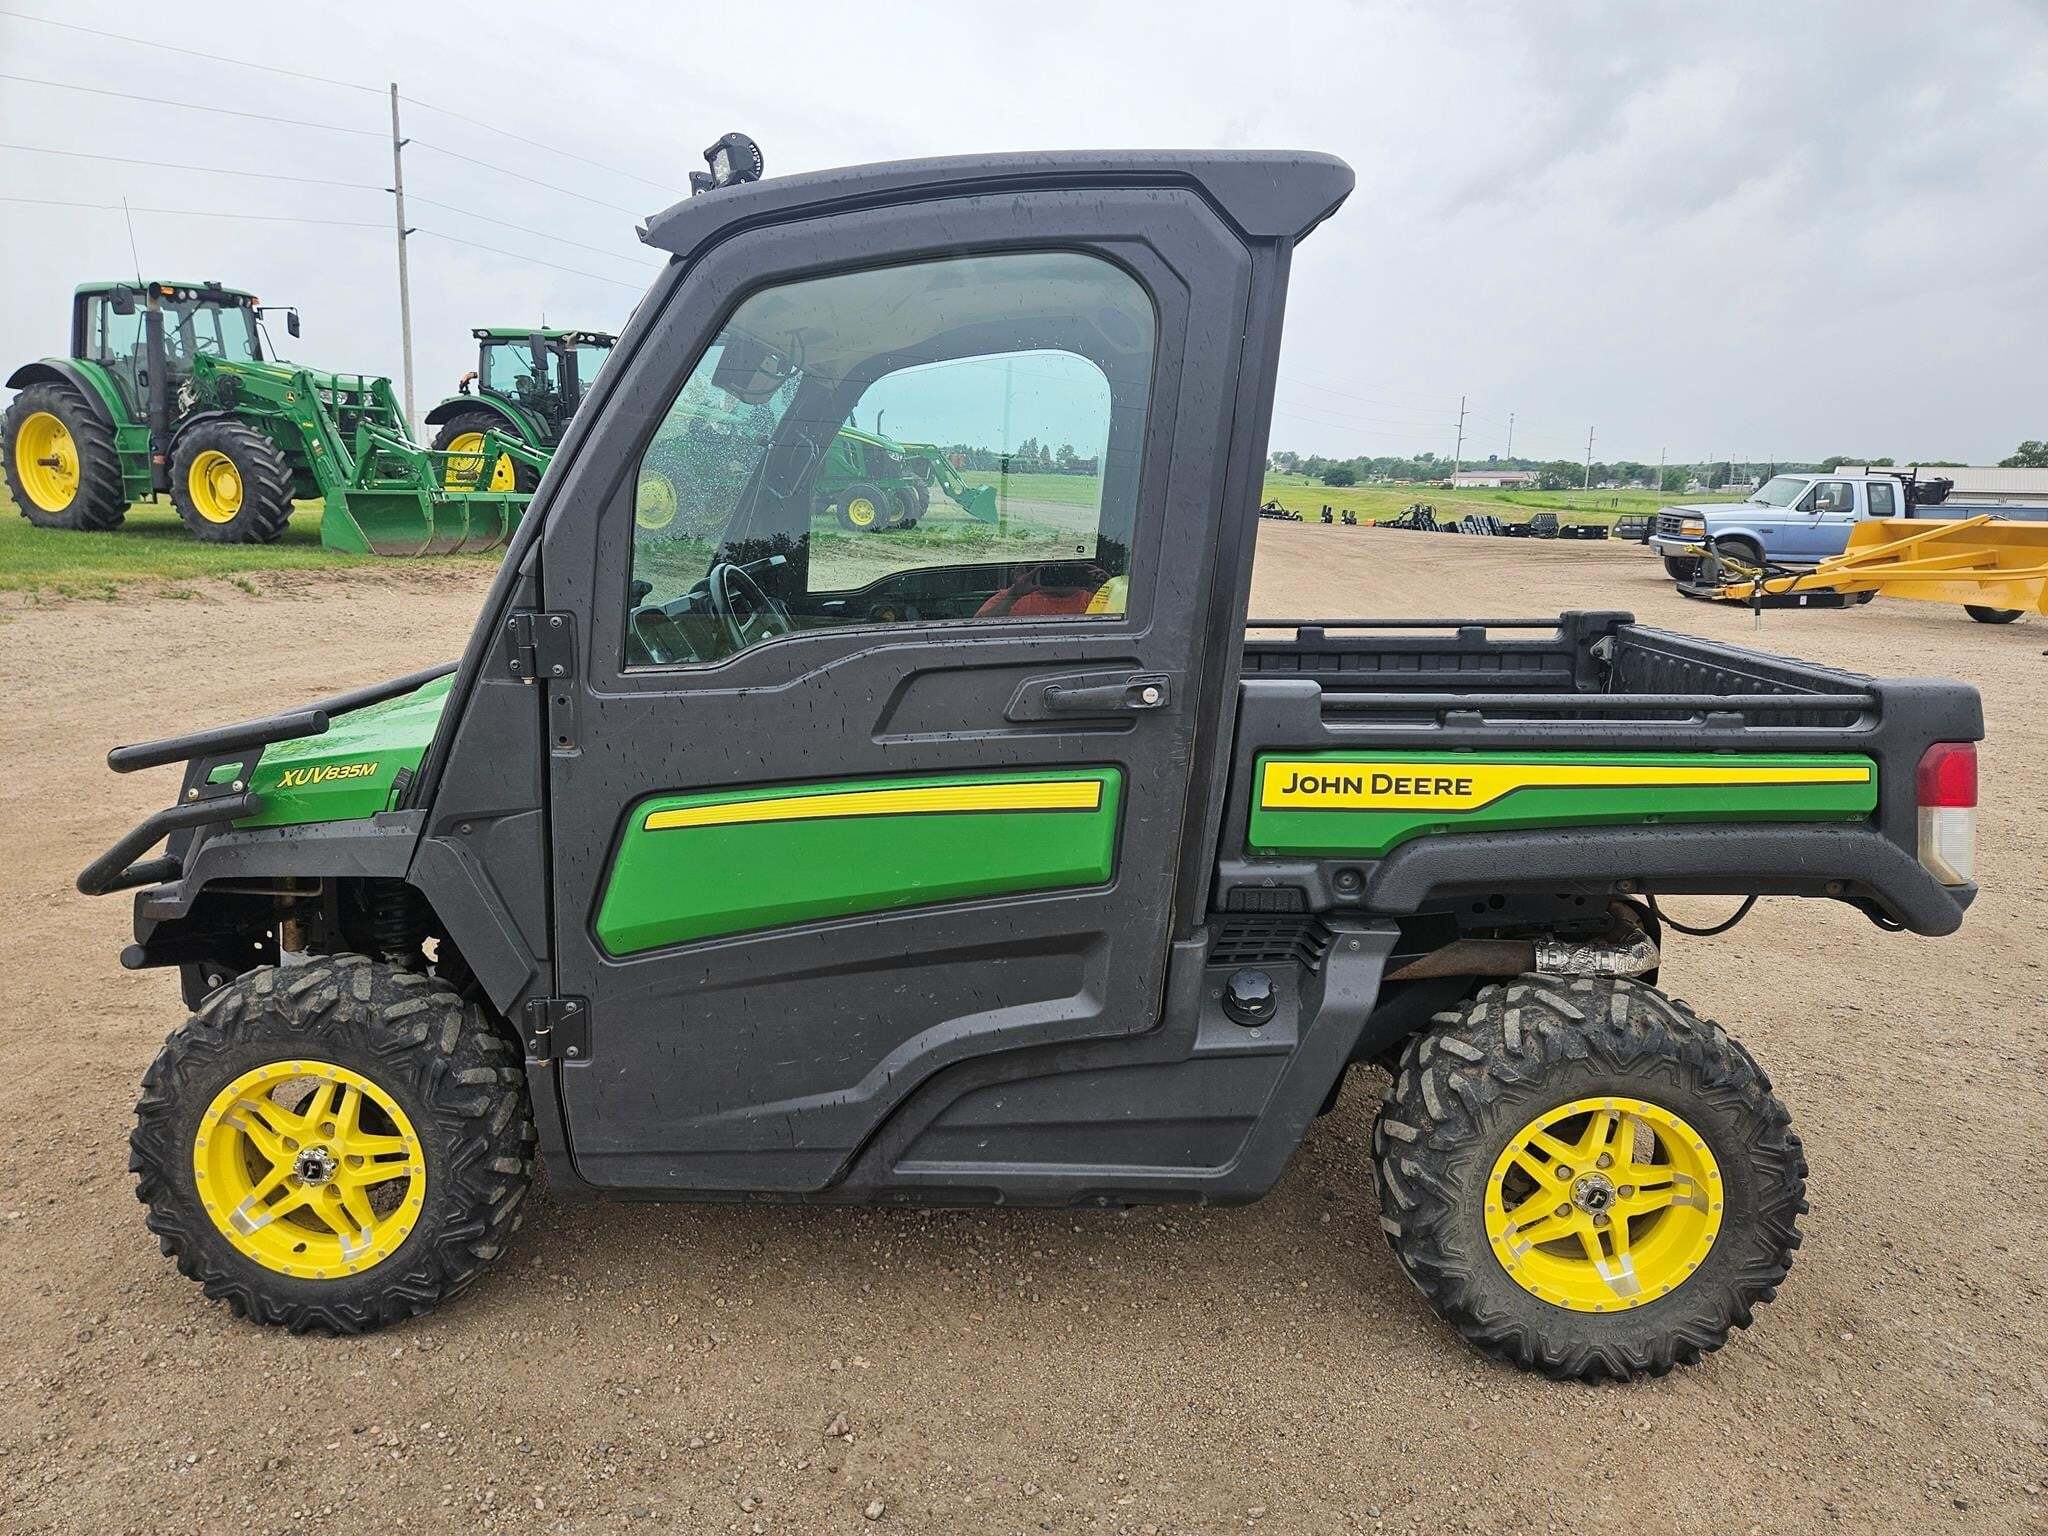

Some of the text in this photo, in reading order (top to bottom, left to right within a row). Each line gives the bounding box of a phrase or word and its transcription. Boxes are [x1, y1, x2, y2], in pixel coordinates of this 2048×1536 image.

[276, 762, 379, 788] XUV835M
[1282, 773, 1473, 796] JOHN DEERE
